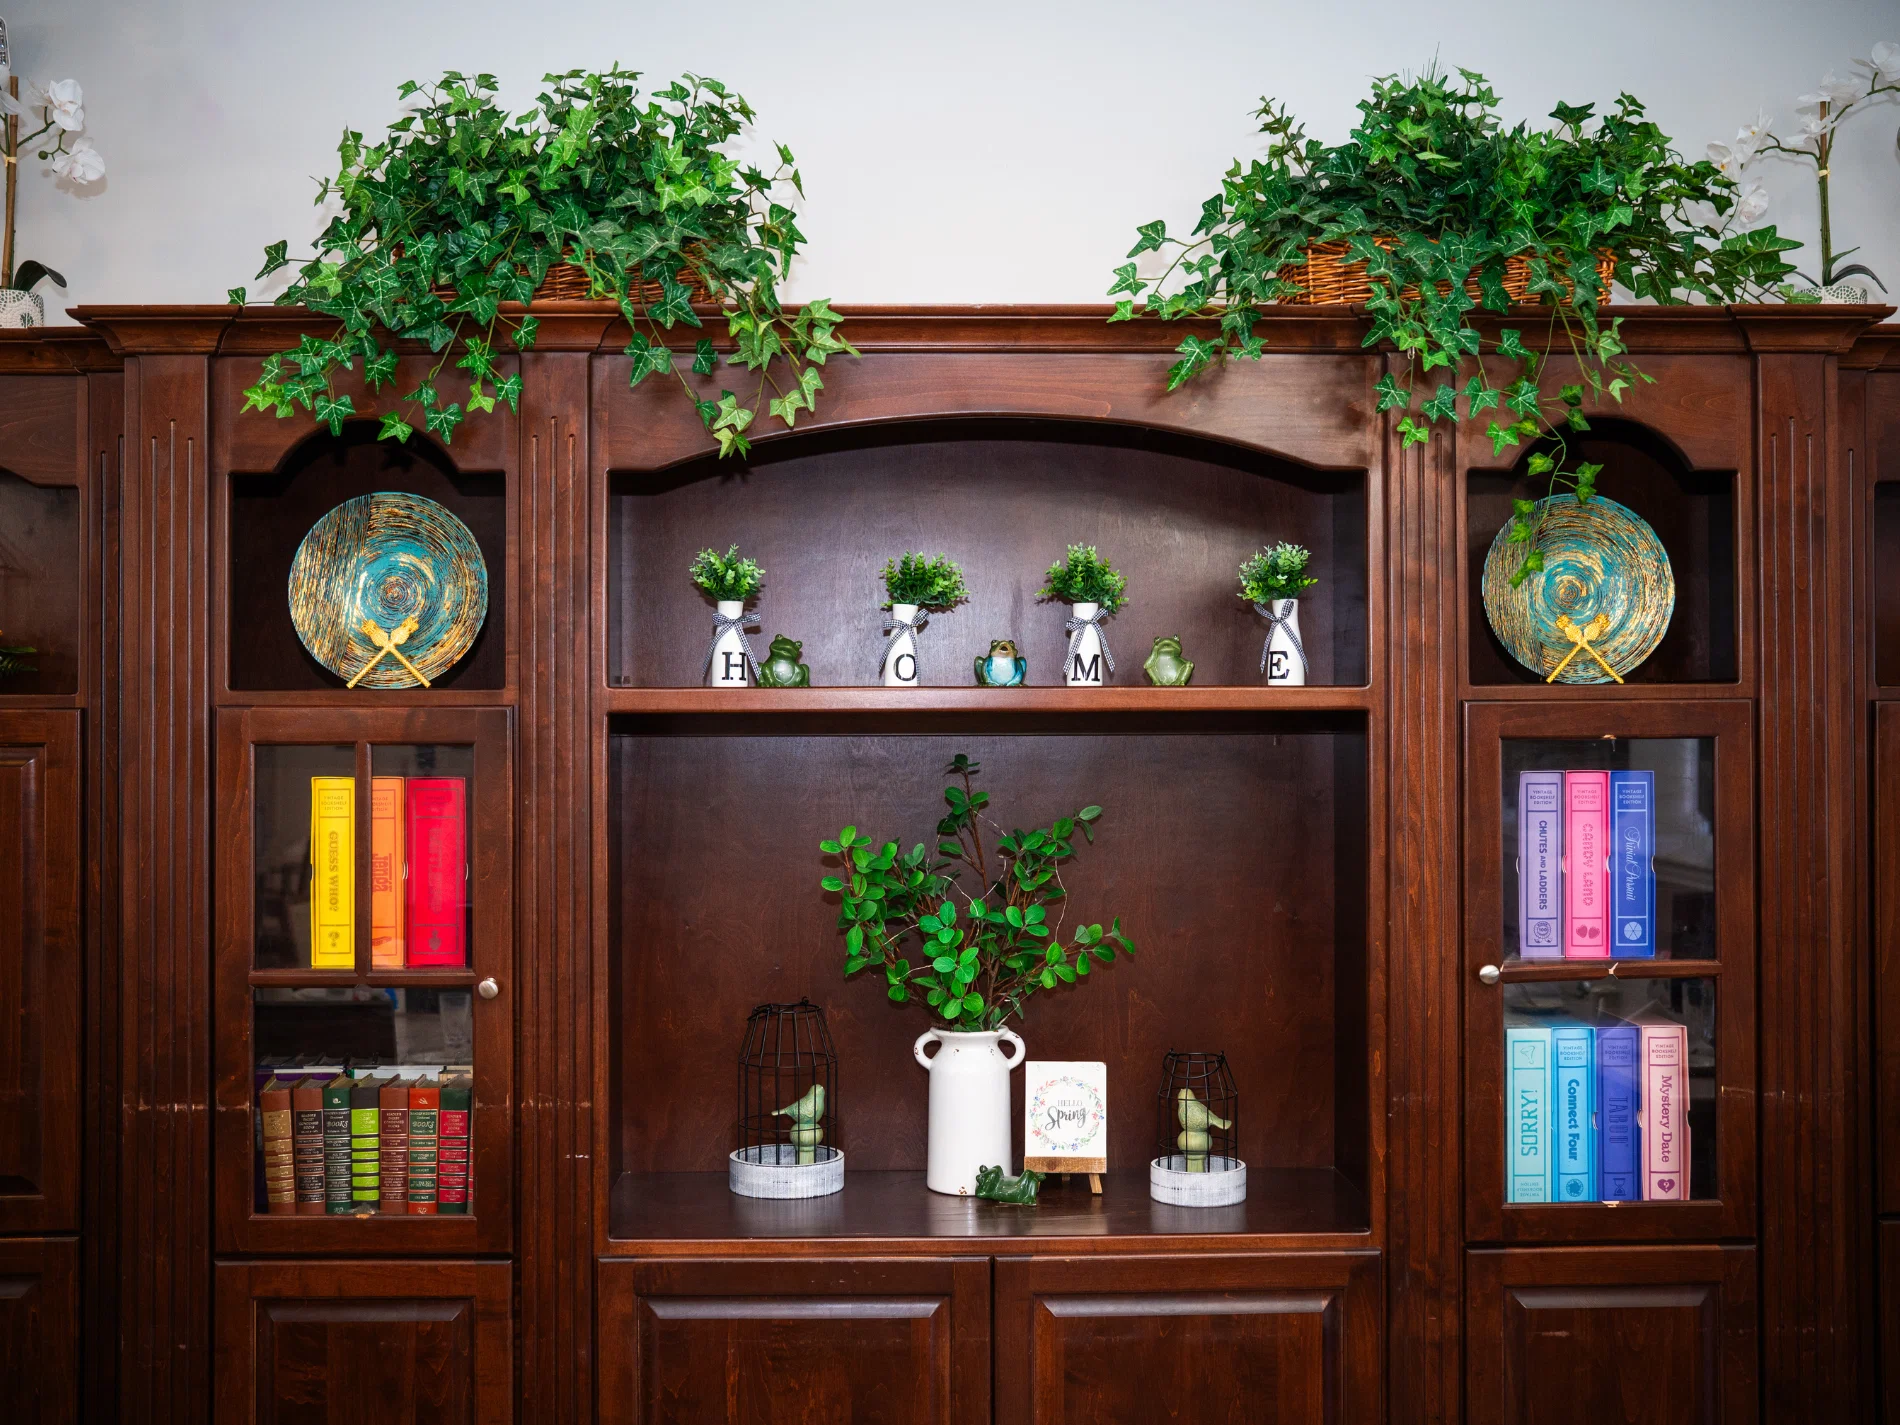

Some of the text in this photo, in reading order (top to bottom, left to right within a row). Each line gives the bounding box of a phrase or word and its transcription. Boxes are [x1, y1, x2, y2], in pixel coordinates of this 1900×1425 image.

[722, 651, 1290, 682] H O M E
[1539, 820, 1547, 854] CHUTES
[1624, 827, 1641, 901] Trivial Pursuit
[329, 830, 339, 912] GUESS WHO?
[1539, 870, 1547, 910] LADDERS
[1045, 1106, 1090, 1131] Spring
[1521, 1089, 1538, 1156] SORRY!
[1568, 1078, 1580, 1161] Connect Four
[1609, 1097, 1628, 1144] TABOO
[1660, 1075, 1673, 1163] Mystery Date
